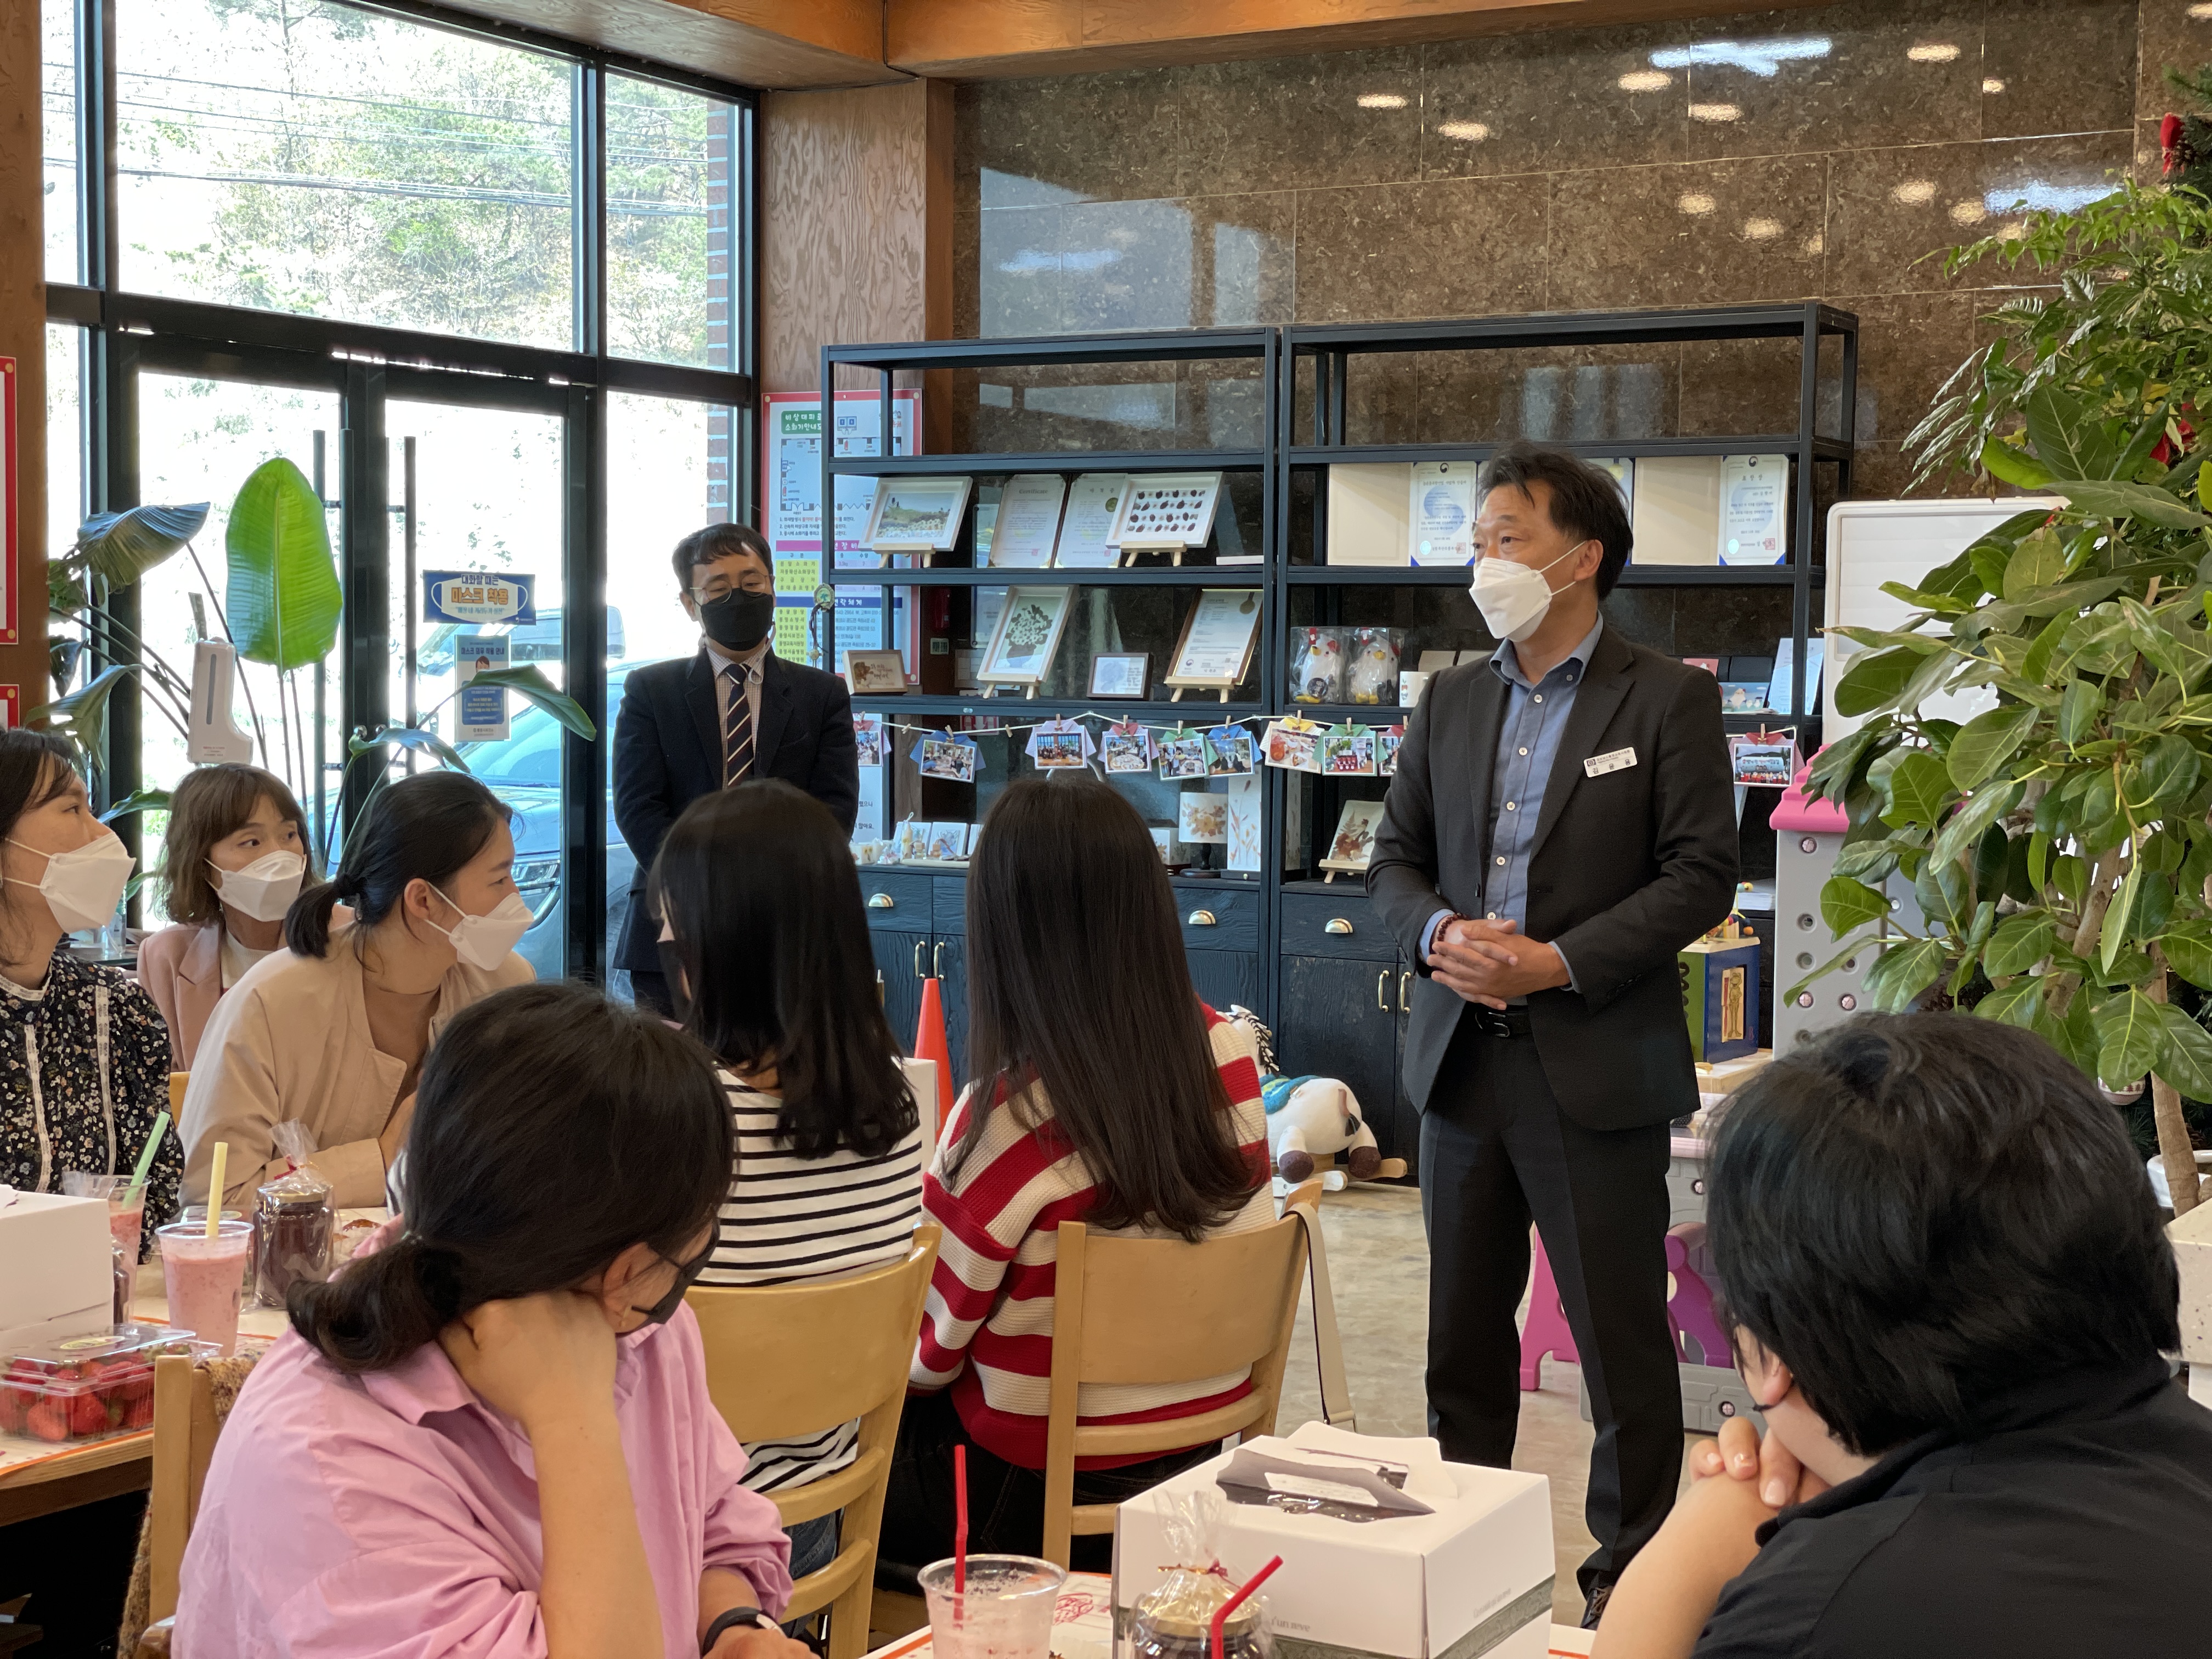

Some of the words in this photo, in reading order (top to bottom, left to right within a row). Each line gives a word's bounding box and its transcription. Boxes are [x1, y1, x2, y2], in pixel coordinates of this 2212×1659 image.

[461, 574, 483, 585] 대화할
[485, 574, 499, 586] 때는
[452, 587, 484, 604] 마스크
[487, 588, 509, 605] 착용
